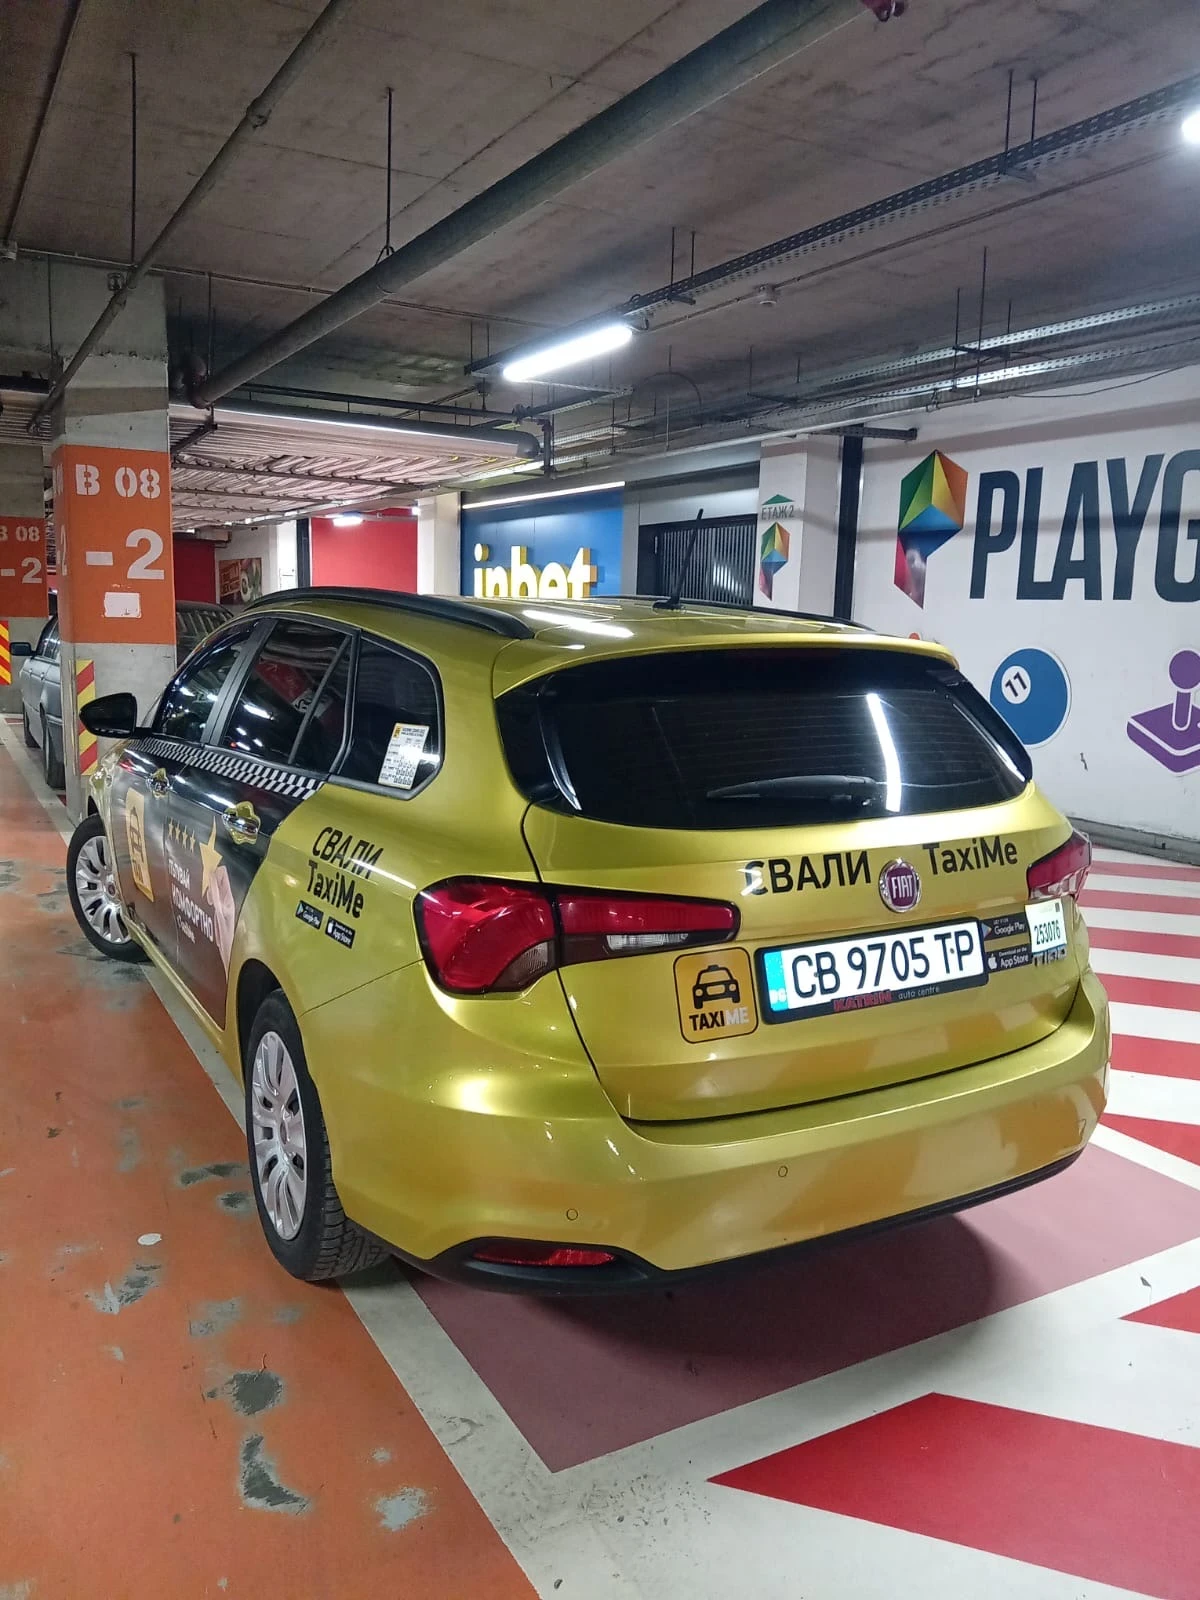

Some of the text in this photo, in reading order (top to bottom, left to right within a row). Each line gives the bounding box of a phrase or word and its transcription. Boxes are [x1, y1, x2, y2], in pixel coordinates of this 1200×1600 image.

[75, 463, 101, 496] B
[114, 466, 161, 499] 08
[761, 504, 795, 520] ЕТАЖ 2
[16, 526, 40, 542] 08
[1004, 671, 1028, 698] 11
[312, 826, 384, 880] СВАЛИ
[744, 835, 1018, 895] СВАЛИ TaxiMe
[306, 859, 364, 919] TaxiMe
[891, 875, 914, 899] FIAT
[994, 924, 1014, 935] Google
[1014, 921, 1025, 932] Play
[1034, 920, 1061, 945] 253076
[791, 929, 975, 998] CB 9705 TP
[1000, 957, 1013, 968] App
[1013, 954, 1029, 965] Store
[834, 986, 940, 1012] KATRIN auto centre
[689, 1007, 749, 1031] TAXIME
